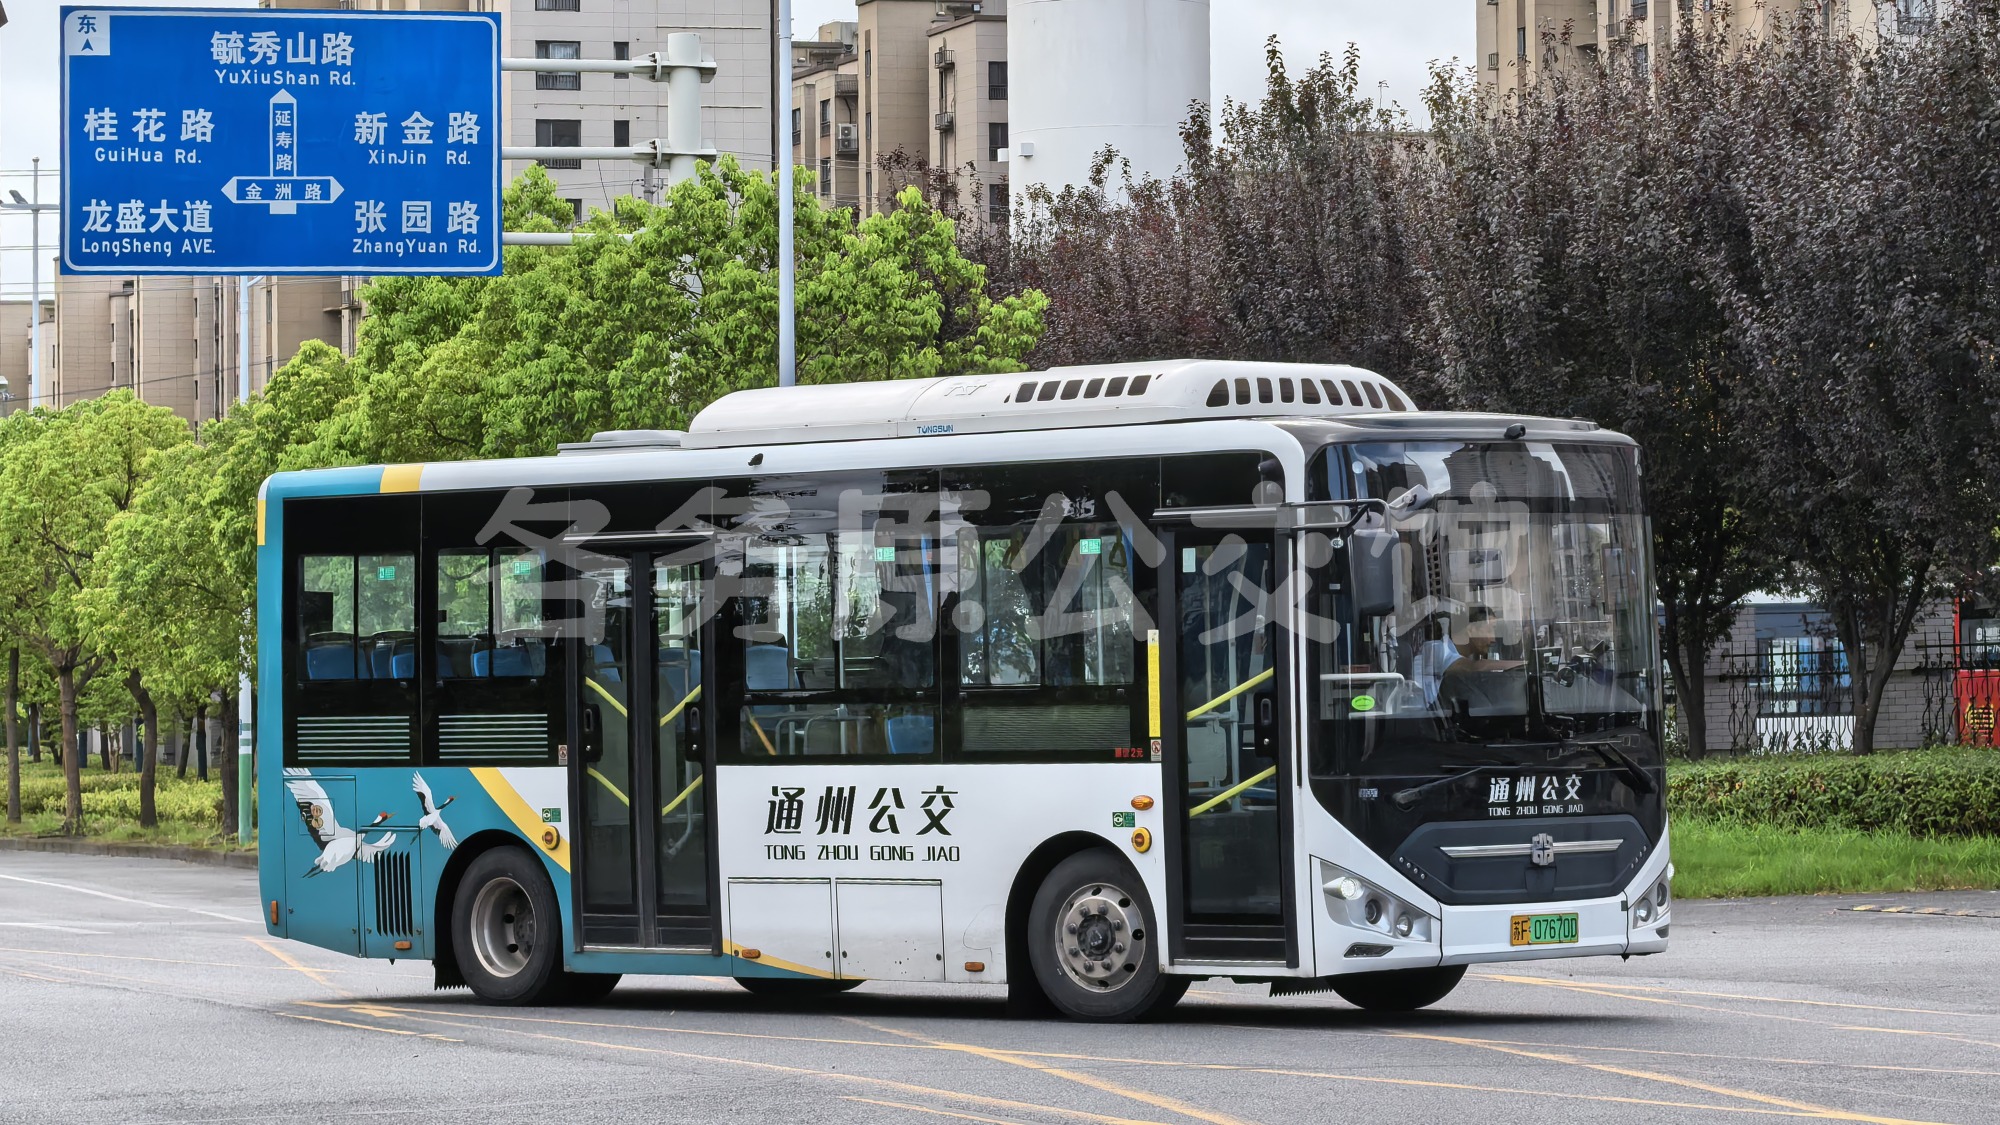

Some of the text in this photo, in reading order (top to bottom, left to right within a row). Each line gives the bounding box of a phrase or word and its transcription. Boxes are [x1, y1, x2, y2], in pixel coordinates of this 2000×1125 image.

[77, 14, 97, 35] 东
[210, 31, 355, 66] 毓秀山路
[214, 69, 356, 86] YuXiuShan Rd.
[84, 107, 216, 143] 桂花路
[354, 111, 481, 146] 新金路
[274, 110, 293, 172] 延寿路
[94, 147, 202, 164] GuiHua Rd.
[368, 149, 471, 165] XinJin Rd.
[245, 182, 322, 201] 金洲路
[82, 199, 214, 234] 龙盛大道
[354, 200, 481, 235] 张园路
[81, 238, 216, 257] LongSheng AVE.
[352, 239, 482, 257] ZhangYuan Rd.
[916, 424, 954, 435] TONGSUN
[1488, 774, 1583, 804] 通州公交
[764, 785, 959, 836] 通州公交
[1488, 803, 1584, 817] TONG ZHOU GONG JIAO
[764, 844, 960, 862] TONG ZHOU GONG JIAO
